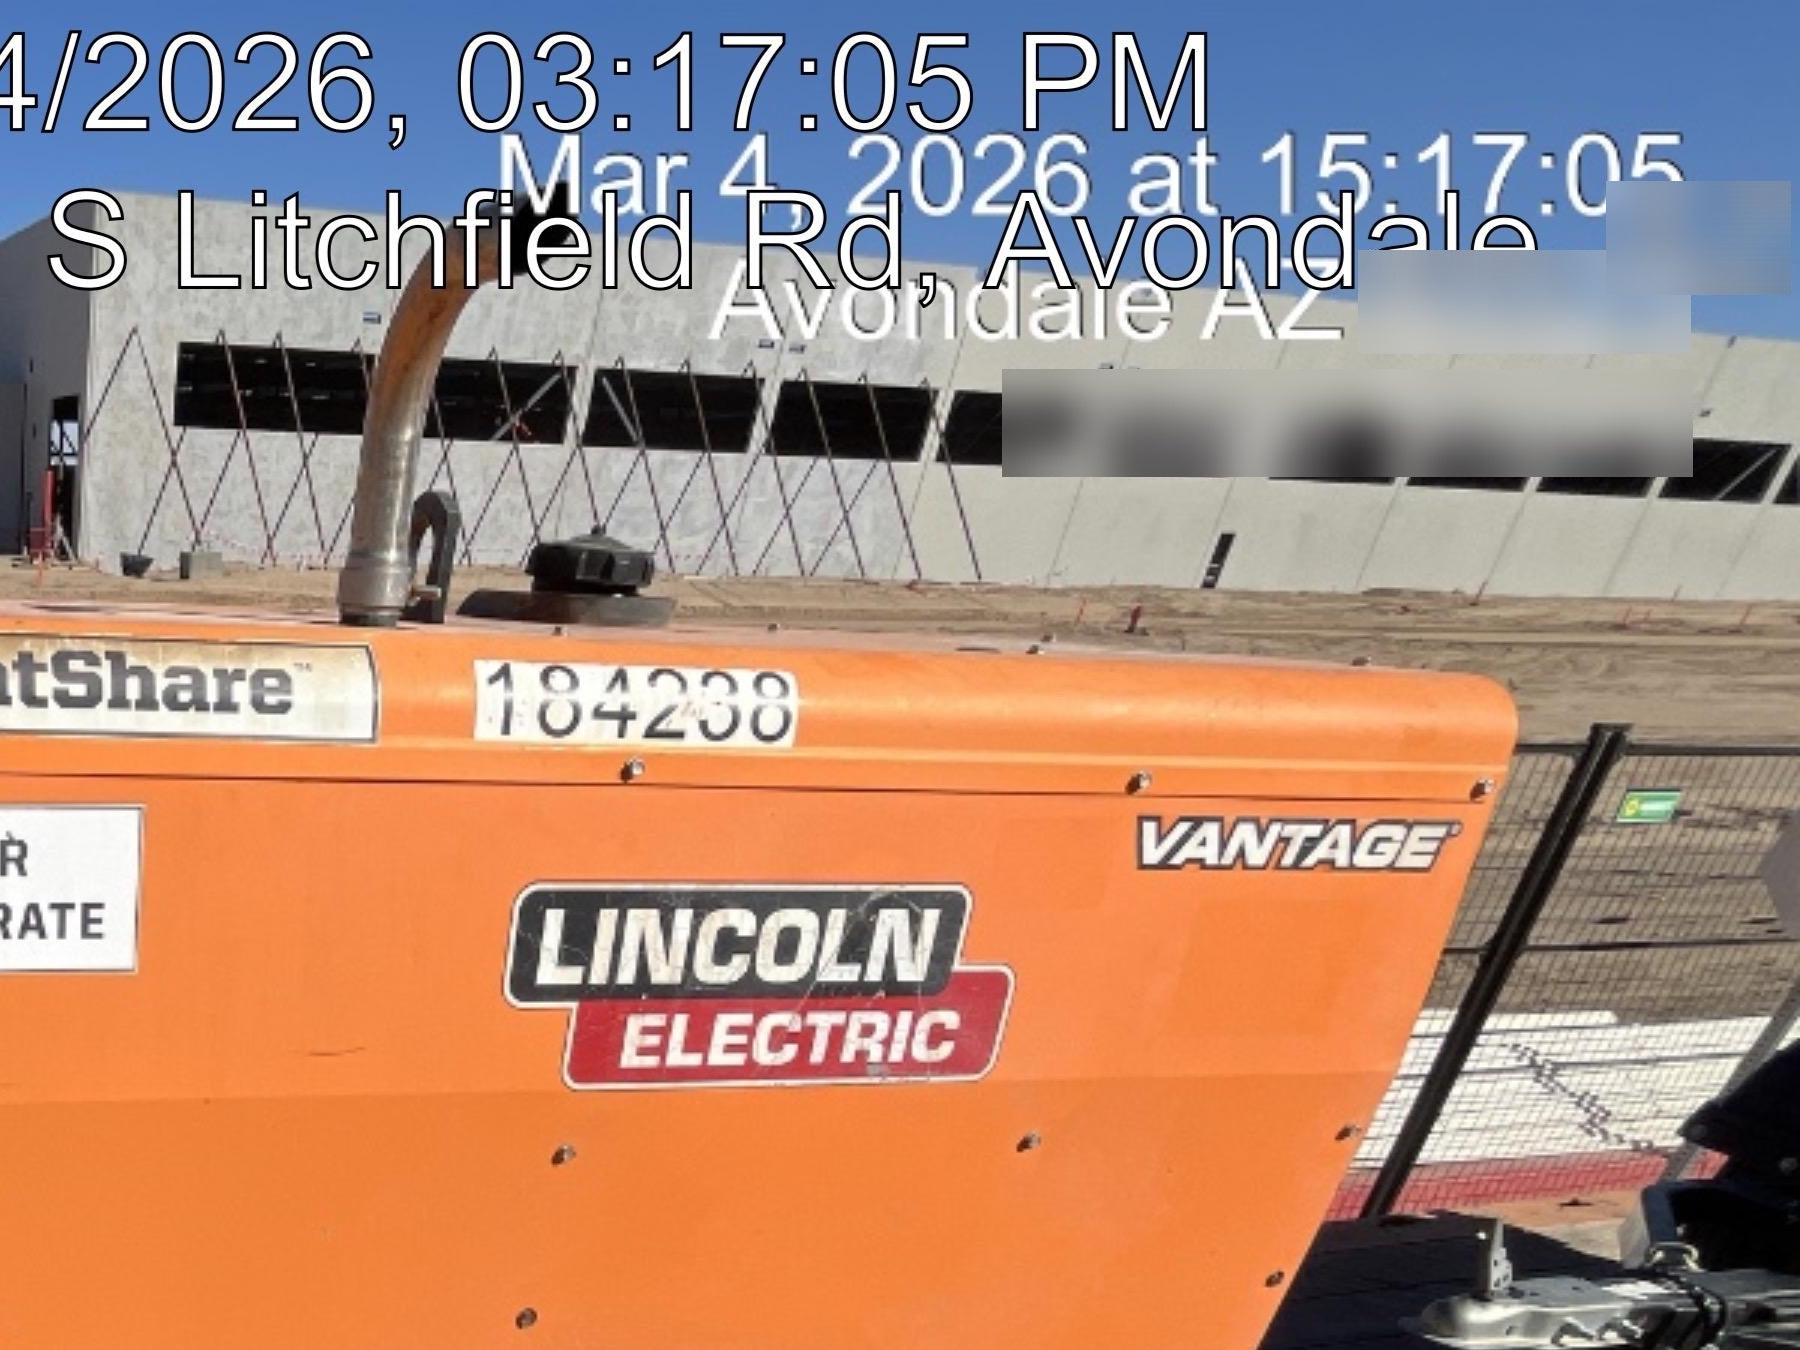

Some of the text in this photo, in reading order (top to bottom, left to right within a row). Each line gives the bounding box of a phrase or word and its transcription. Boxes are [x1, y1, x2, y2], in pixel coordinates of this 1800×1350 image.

[487, 662, 793, 743] 184238
[1138, 818, 1450, 872] VANTAGE
[535, 908, 942, 985] LINCOLN
[619, 1009, 961, 1069] ELECTRIC
